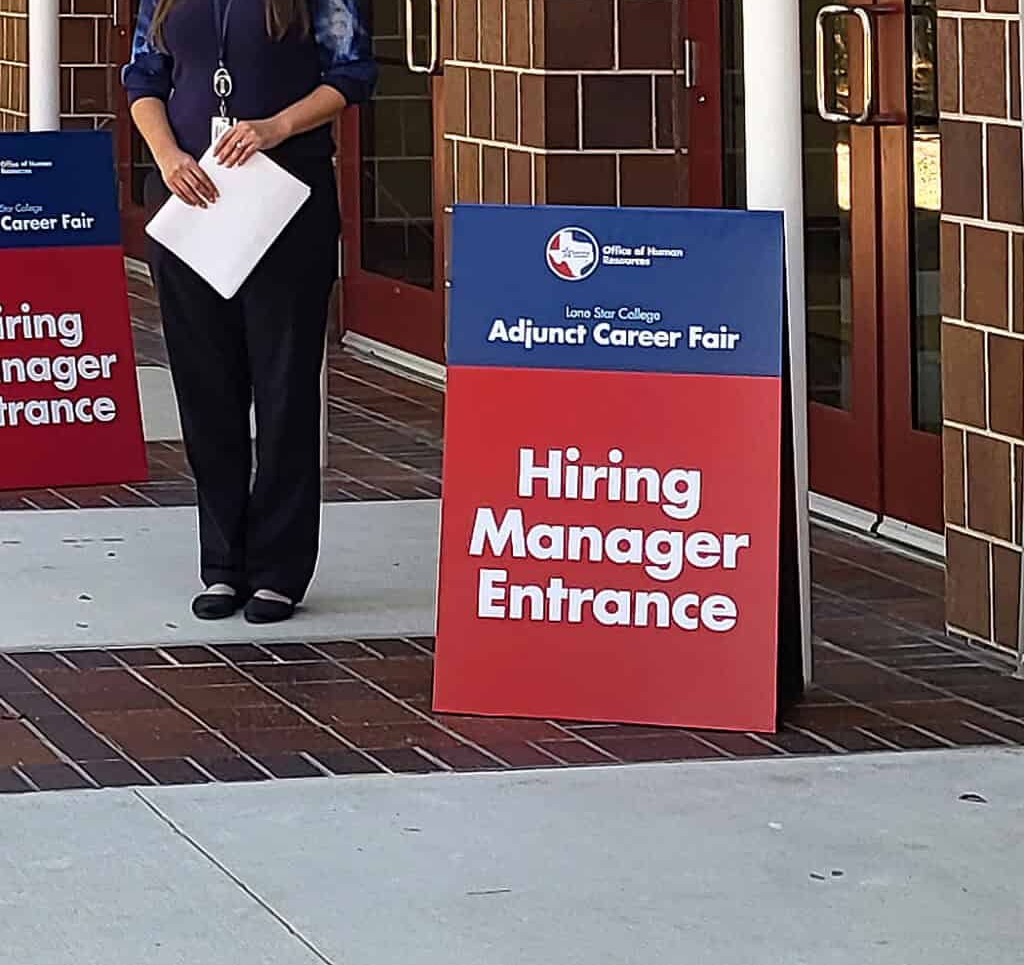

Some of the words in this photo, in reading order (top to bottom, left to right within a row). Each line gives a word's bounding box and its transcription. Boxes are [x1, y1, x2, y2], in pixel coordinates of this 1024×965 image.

[0, 215, 58, 232] Career
[62, 211, 95, 230] Fair
[602, 245, 632, 256] Office
[634, 245, 645, 256] of
[647, 246, 684, 257] Human
[566, 306, 591, 319] Lone
[594, 307, 616, 320] Star
[618, 308, 661, 324] College
[487, 318, 587, 349] Adjunct
[593, 323, 682, 348] Career
[689, 325, 740, 350] Fair
[517, 446, 702, 520] Hiring
[468, 507, 750, 581] Manager
[477, 568, 738, 632] Entrance
